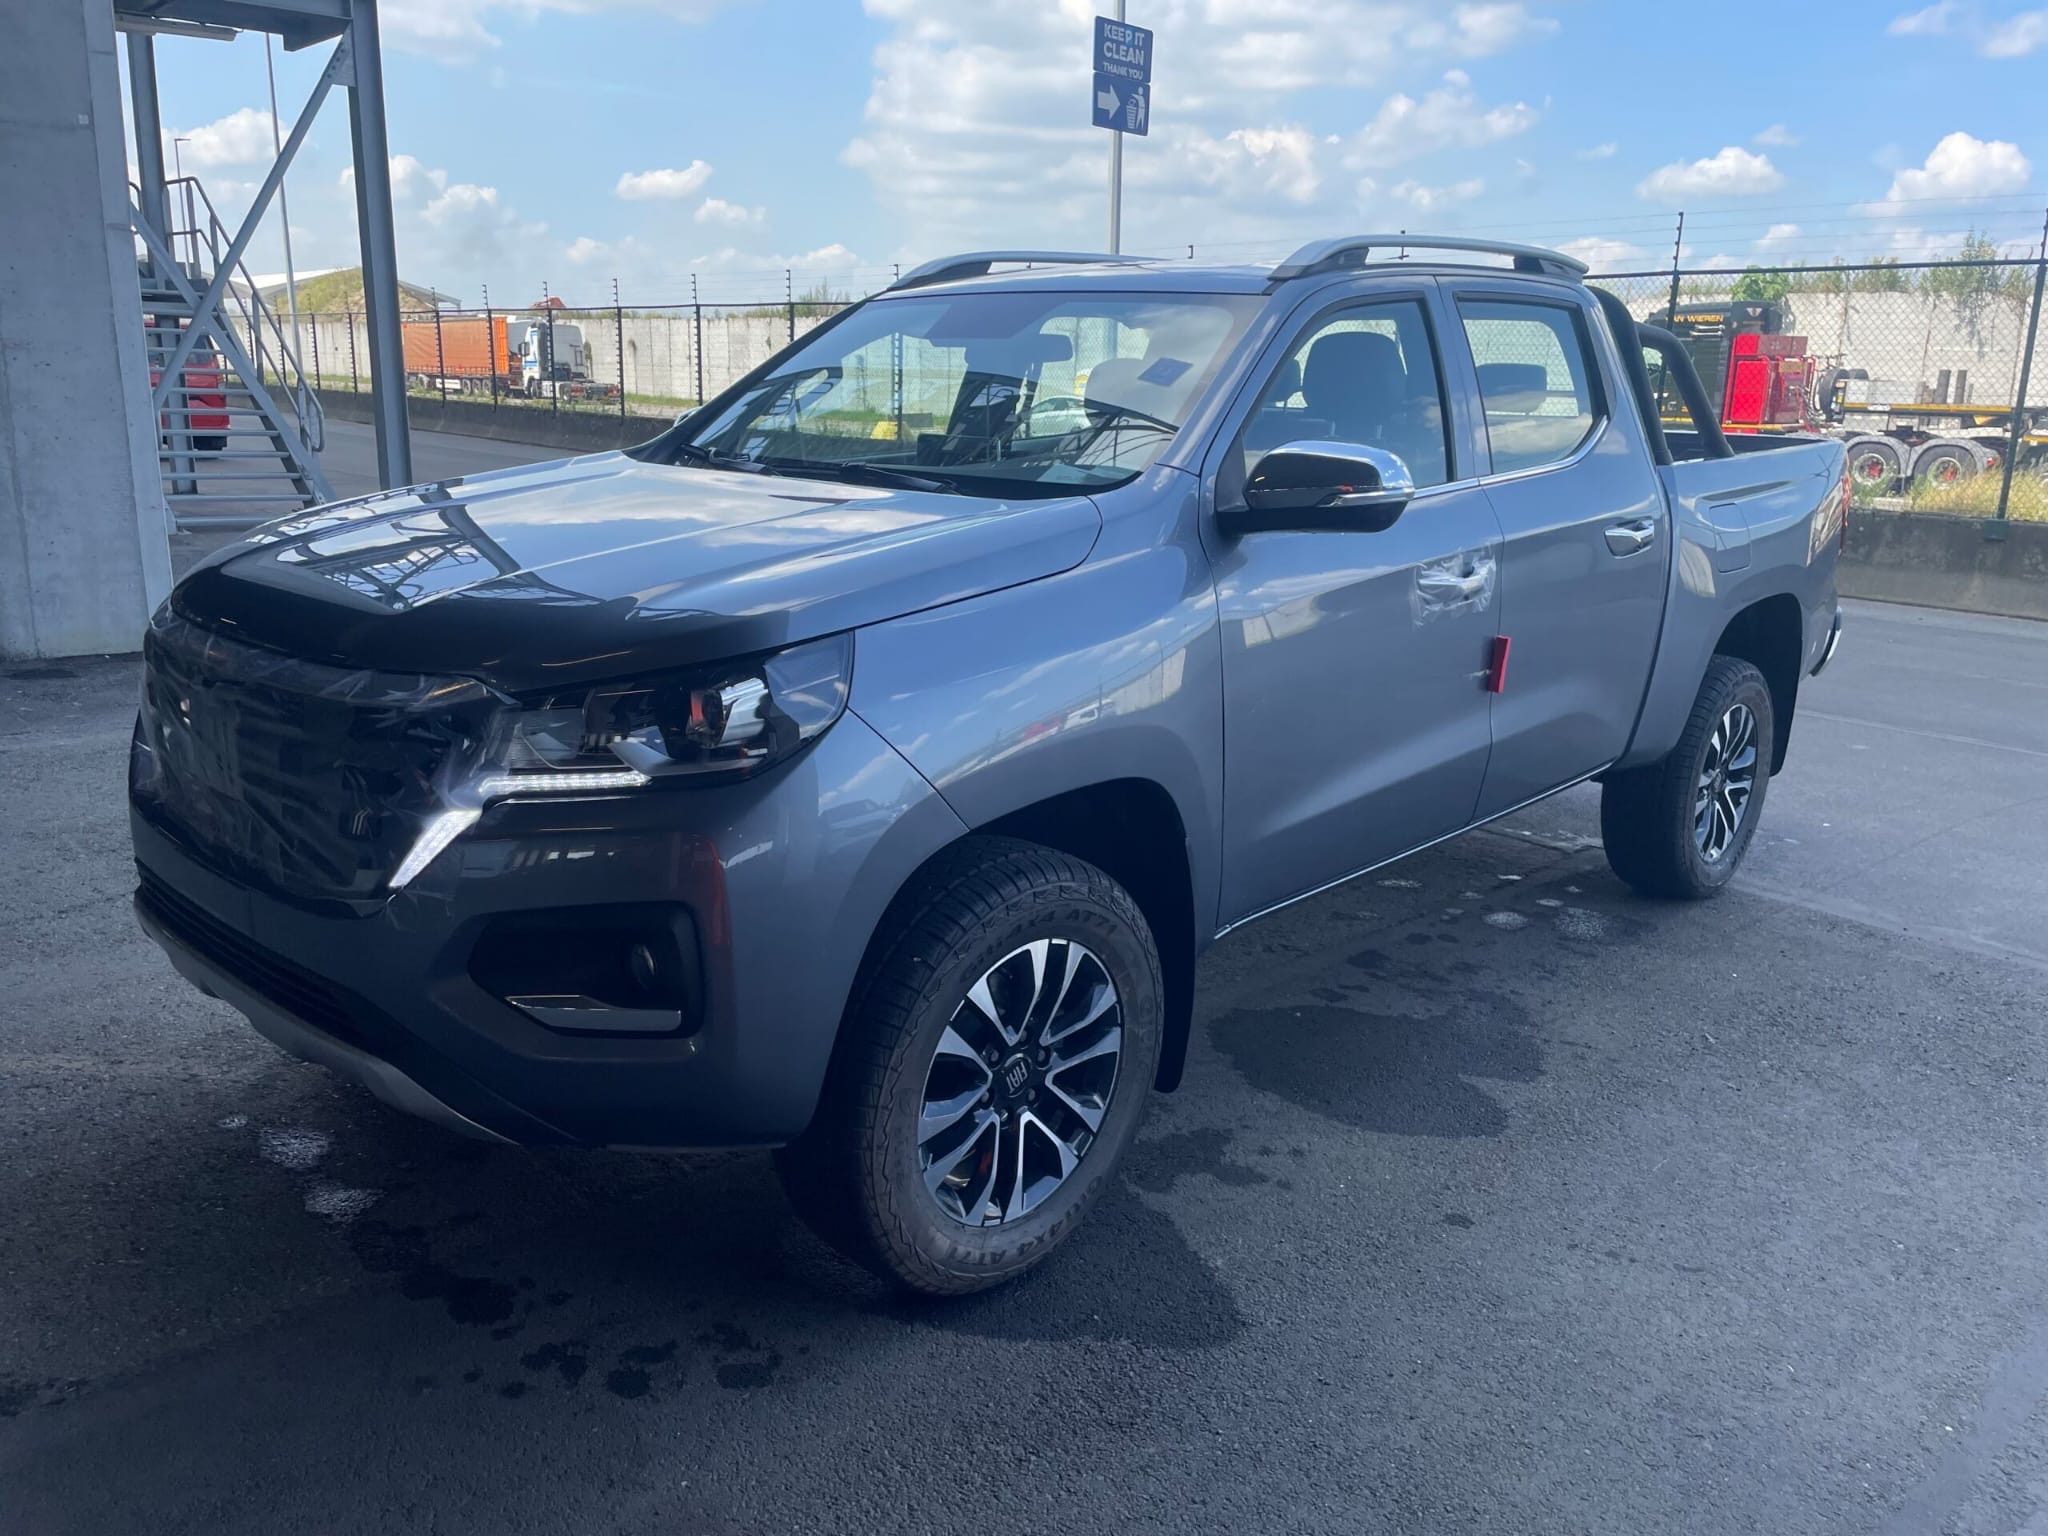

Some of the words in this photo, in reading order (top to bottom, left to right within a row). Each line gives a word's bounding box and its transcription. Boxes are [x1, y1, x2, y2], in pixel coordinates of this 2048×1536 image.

[1104, 23, 1133, 44] KEEP
[1134, 31, 1145, 47] IT
[1103, 41, 1144, 66] CLEAN
[1103, 62, 1127, 77] THANK
[1128, 68, 1143, 80] YOU
[1005, 1061, 1029, 1094] FIAT
